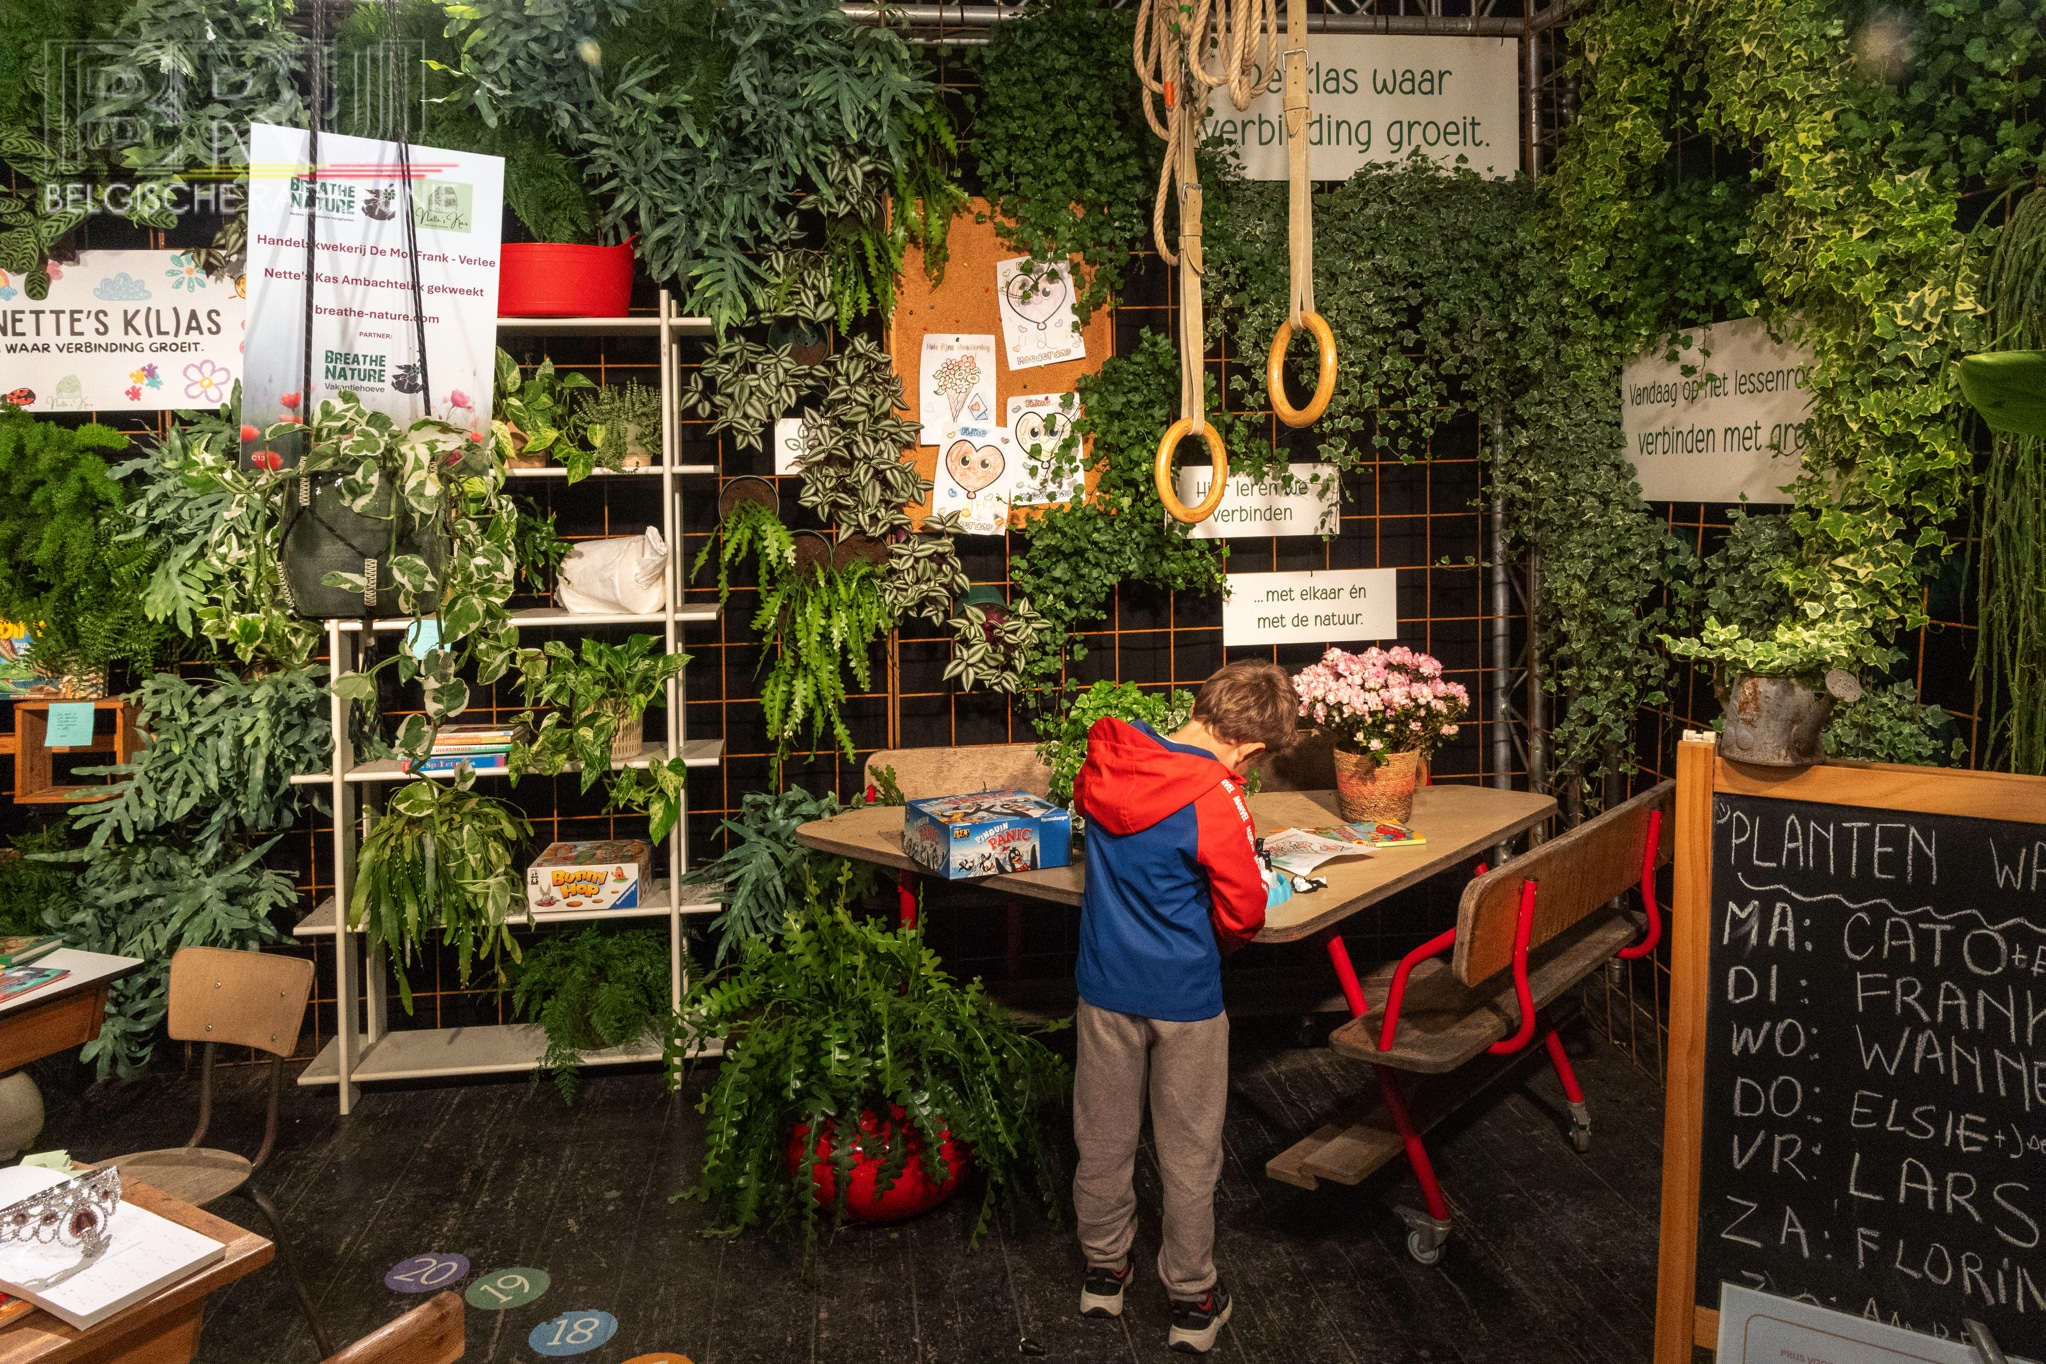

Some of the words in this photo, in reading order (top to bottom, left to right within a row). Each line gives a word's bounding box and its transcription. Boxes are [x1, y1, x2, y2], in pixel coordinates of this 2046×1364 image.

[1308, 61, 1358, 94] las
[1373, 66, 1453, 96] waar
[1202, 112, 1372, 153] verbiding
[1387, 115, 1490, 153] groeit.
[370, 245, 387, 257] De
[458, 255, 496, 268] Verlee
[315, 272, 339, 284] Kas
[427, 285, 484, 298] gekweekt
[123, 306, 222, 338] K(L)AS
[359, 331, 393, 339] PARTNER:
[5, 343, 51, 354] WAAR
[55, 341, 145, 354] VERBINDING
[149, 341, 205, 353] GROEIT.
[325, 350, 386, 367] BREATHE
[325, 365, 386, 383] NATURE
[325, 382, 385, 393] Vakantiehoeve
[1629, 381, 1678, 408] Vandaag
[1638, 423, 1716, 456] verbinden
[1723, 420, 1763, 453] met
[1236, 480, 1278, 497] leren
[1212, 504, 1293, 523] verbinden
[1300, 585, 1345, 601] elkaar
[1349, 584, 1367, 599] én
[1257, 614, 1286, 629] met
[1291, 612, 1309, 628] de
[1314, 612, 1364, 628] natuur.
[1232, 795, 1250, 823] MARVEL
[974, 821, 1009, 845] PINGUIN
[987, 827, 1033, 852] PANIC
[551, 870, 608, 887] Bunny
[560, 882, 600, 900] Hop
[1849, 1152, 2039, 1249] LARS
[393, 1257, 459, 1286] 20
[479, 1274, 531, 1304] 19
[546, 1317, 600, 1347] 18
